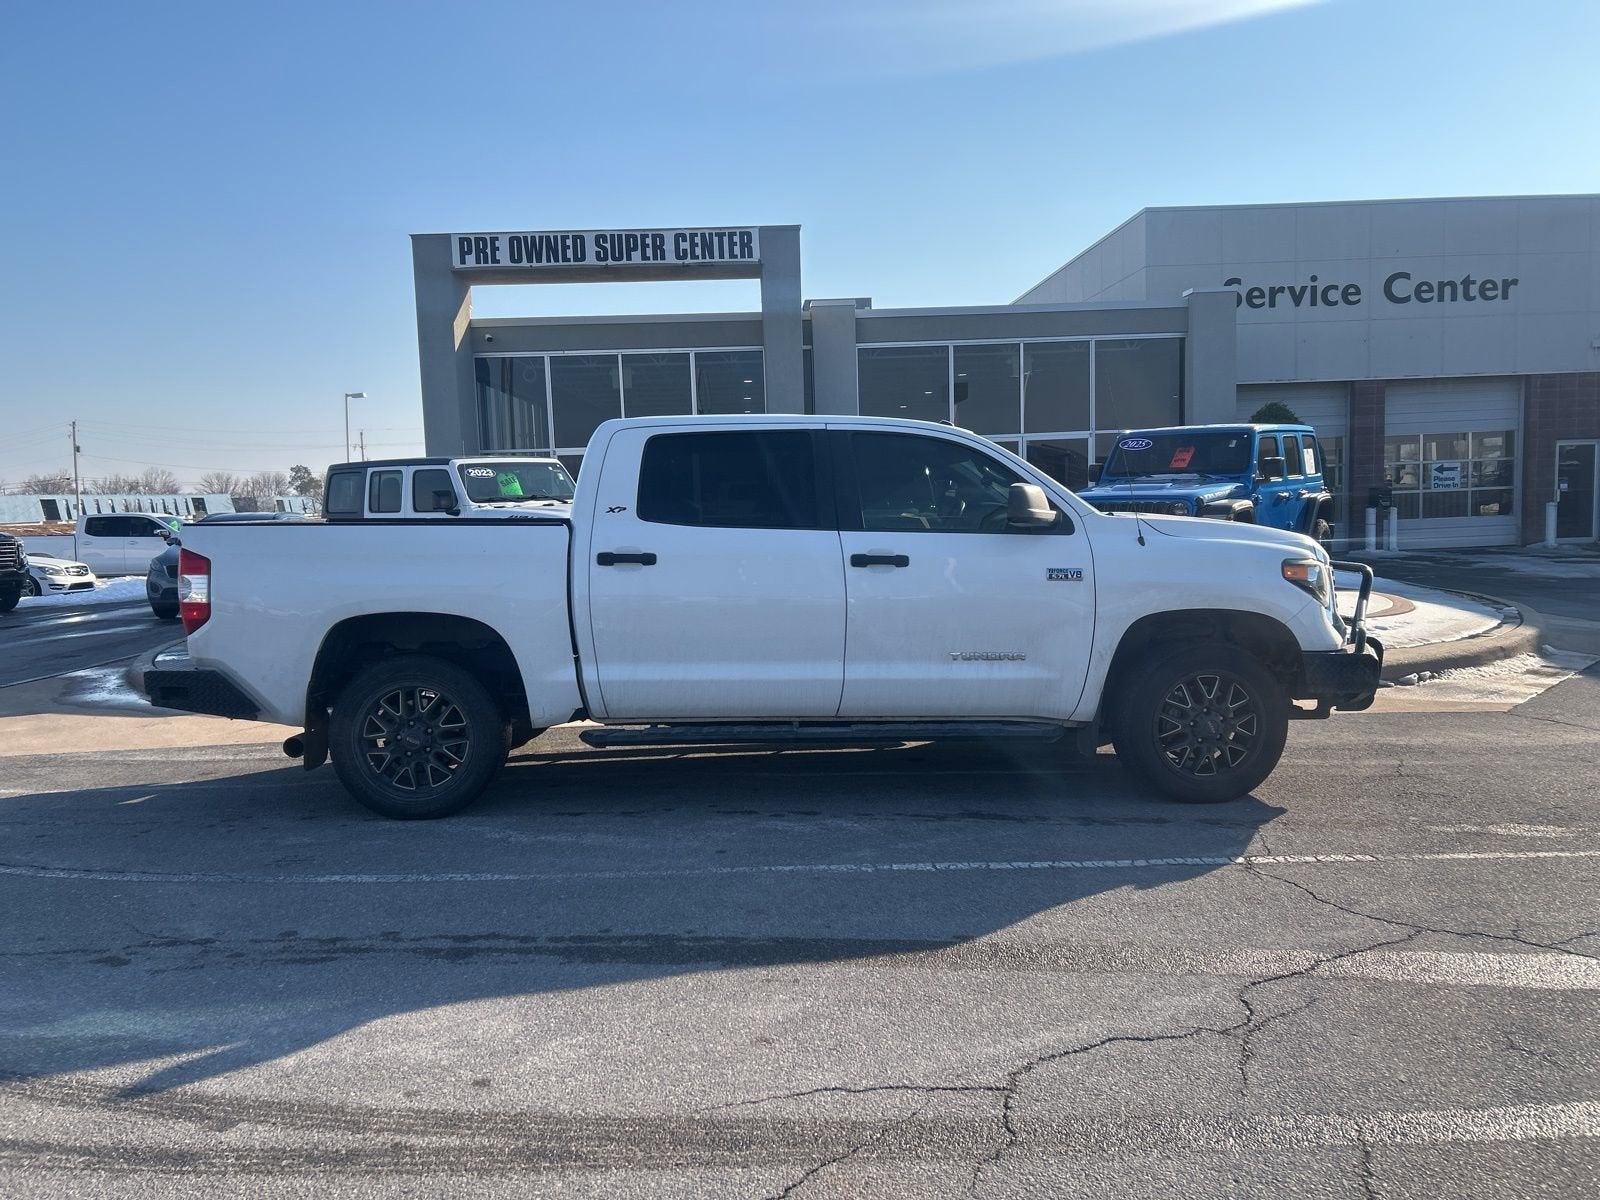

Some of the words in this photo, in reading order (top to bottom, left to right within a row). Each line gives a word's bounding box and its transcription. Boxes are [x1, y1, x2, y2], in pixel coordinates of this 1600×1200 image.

[458, 236, 500, 265] PRE
[508, 234, 586, 264] OWNED
[595, 233, 666, 262] SUPER
[673, 231, 754, 260] CENTER
[1383, 271, 1519, 304] Center
[468, 469, 494, 477] 2023
[500, 476, 518, 486] SALE
[1069, 570, 1082, 579] V8
[949, 651, 1026, 661] TUNDRA
